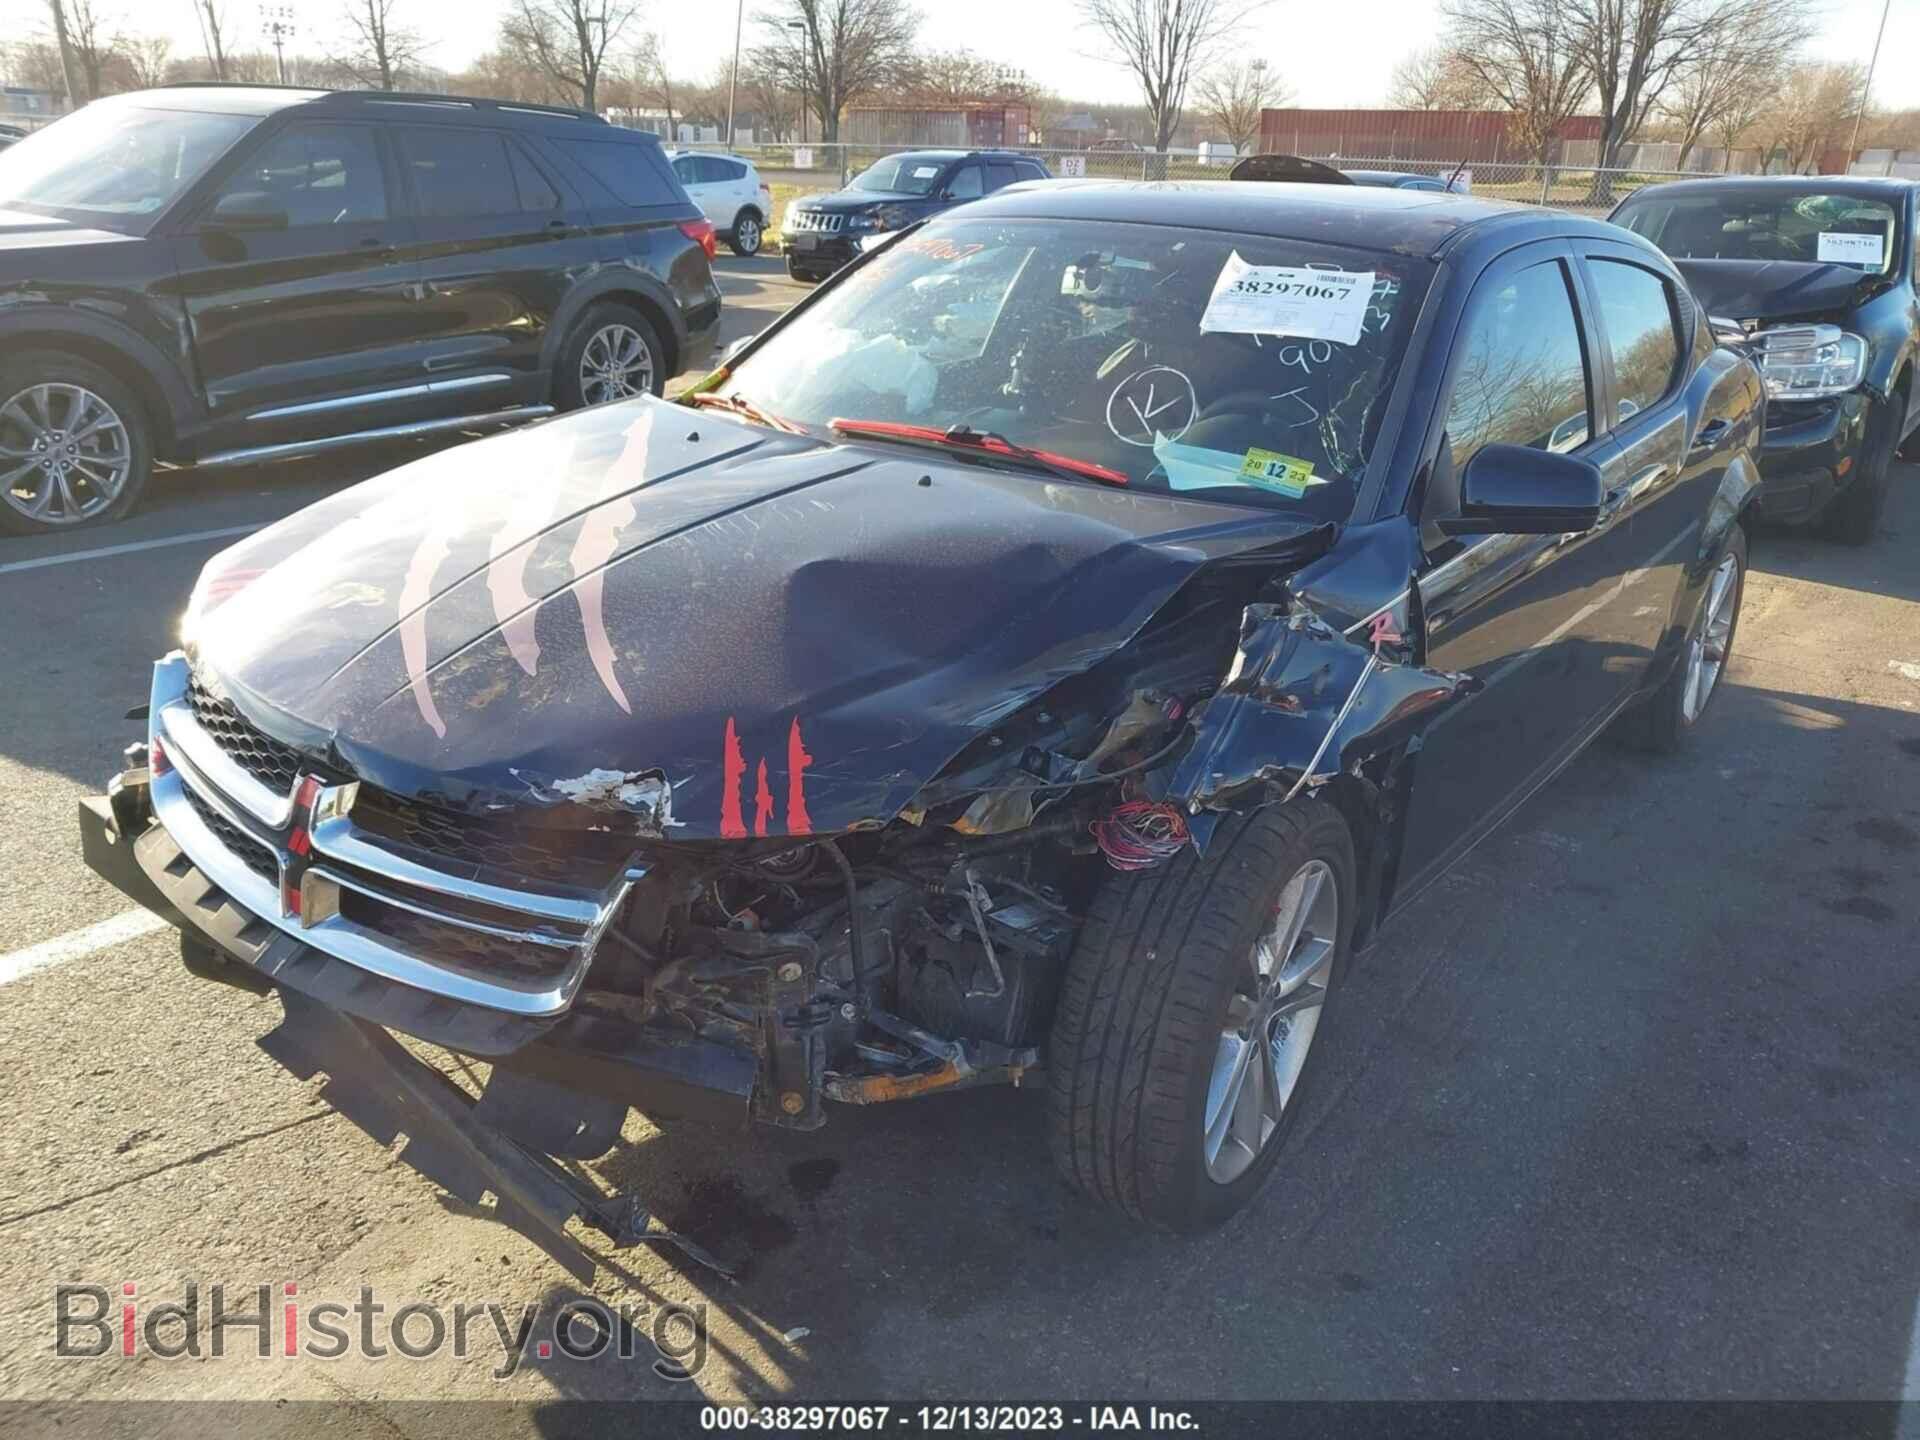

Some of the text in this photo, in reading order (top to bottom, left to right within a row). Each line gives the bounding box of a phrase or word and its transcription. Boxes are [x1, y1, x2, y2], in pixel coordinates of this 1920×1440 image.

[1229, 280, 1351, 300] 38297067
[1247, 459, 1306, 482] 20 12 23
